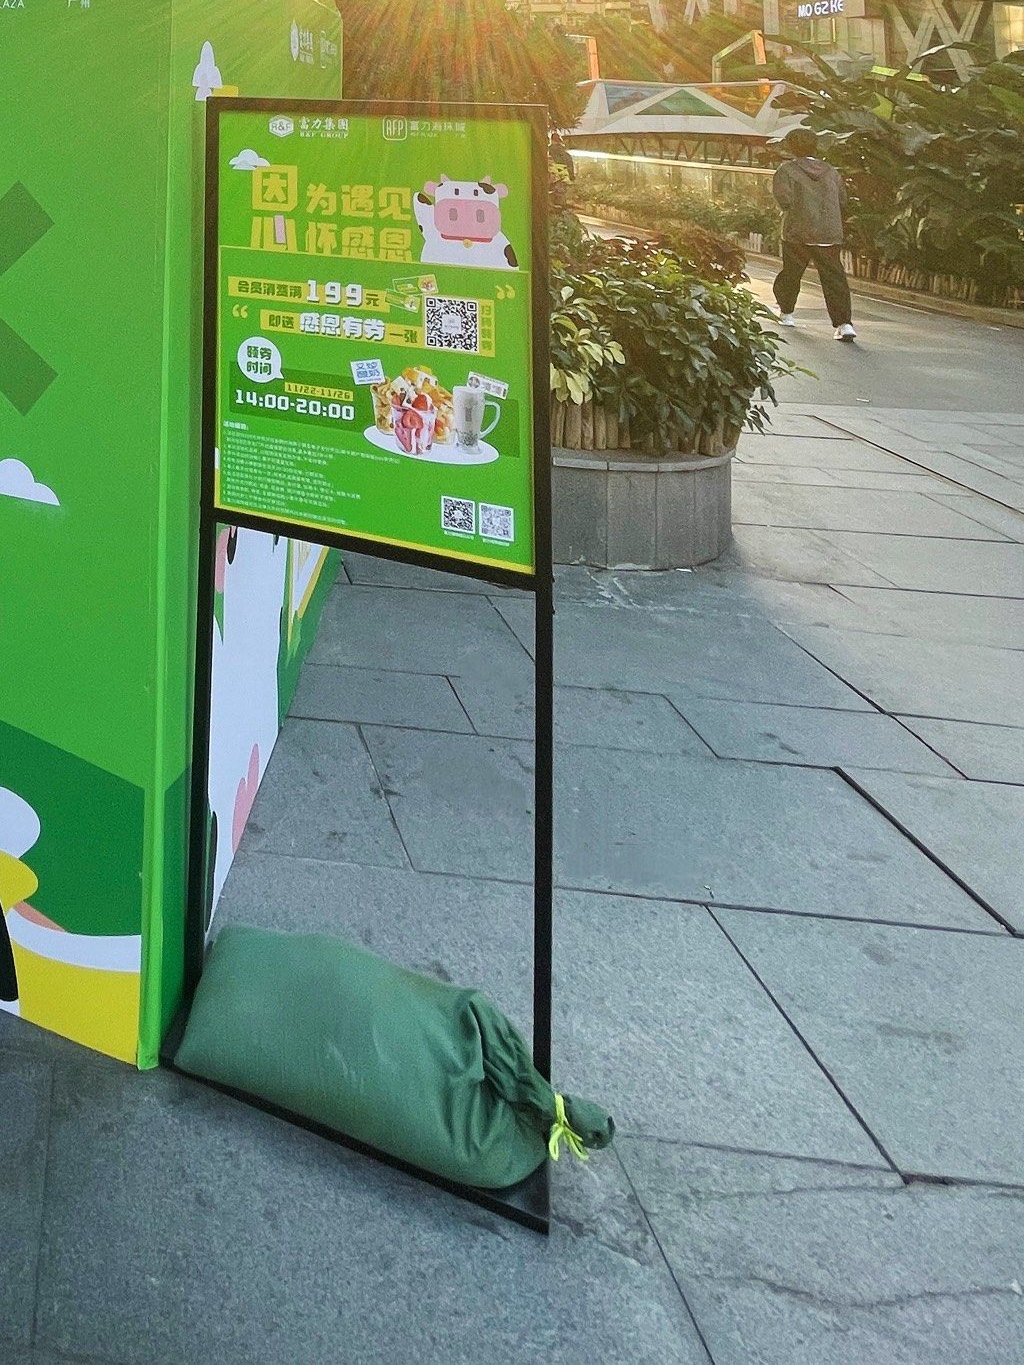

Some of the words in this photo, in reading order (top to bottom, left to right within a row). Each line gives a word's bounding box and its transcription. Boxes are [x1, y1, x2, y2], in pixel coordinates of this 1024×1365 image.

[250, 164, 412, 222] 因为遇见
[249, 214, 413, 263] 心怀感恩
[246, 360, 272, 376] 时间
[235, 388, 355, 421] 14:00-20:00
